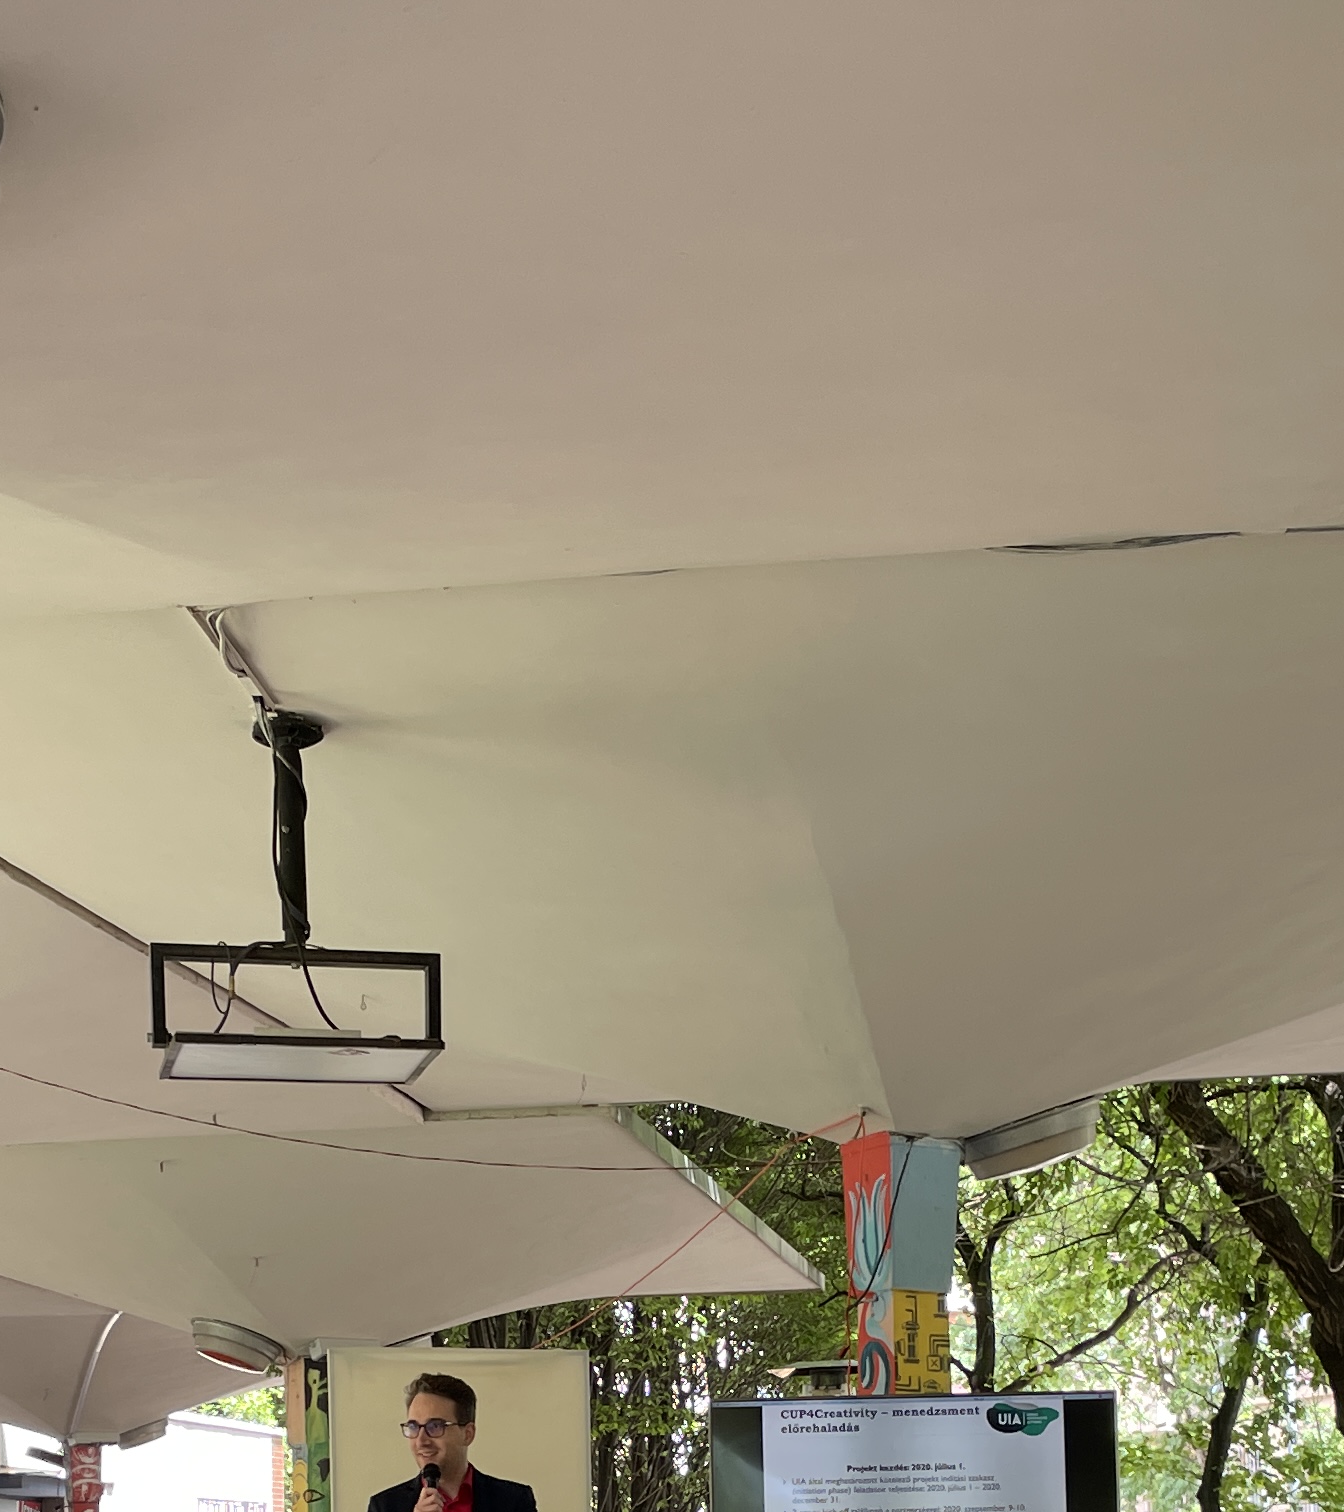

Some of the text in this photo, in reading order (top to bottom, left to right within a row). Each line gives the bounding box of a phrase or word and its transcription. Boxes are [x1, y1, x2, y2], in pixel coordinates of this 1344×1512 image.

[780, 1408, 878, 1420] CUP4Creativity
[892, 1406, 980, 1417] menedzsment
[998, 1413, 1022, 1425] UIA
[781, 1422, 860, 1434] előrehaladás
